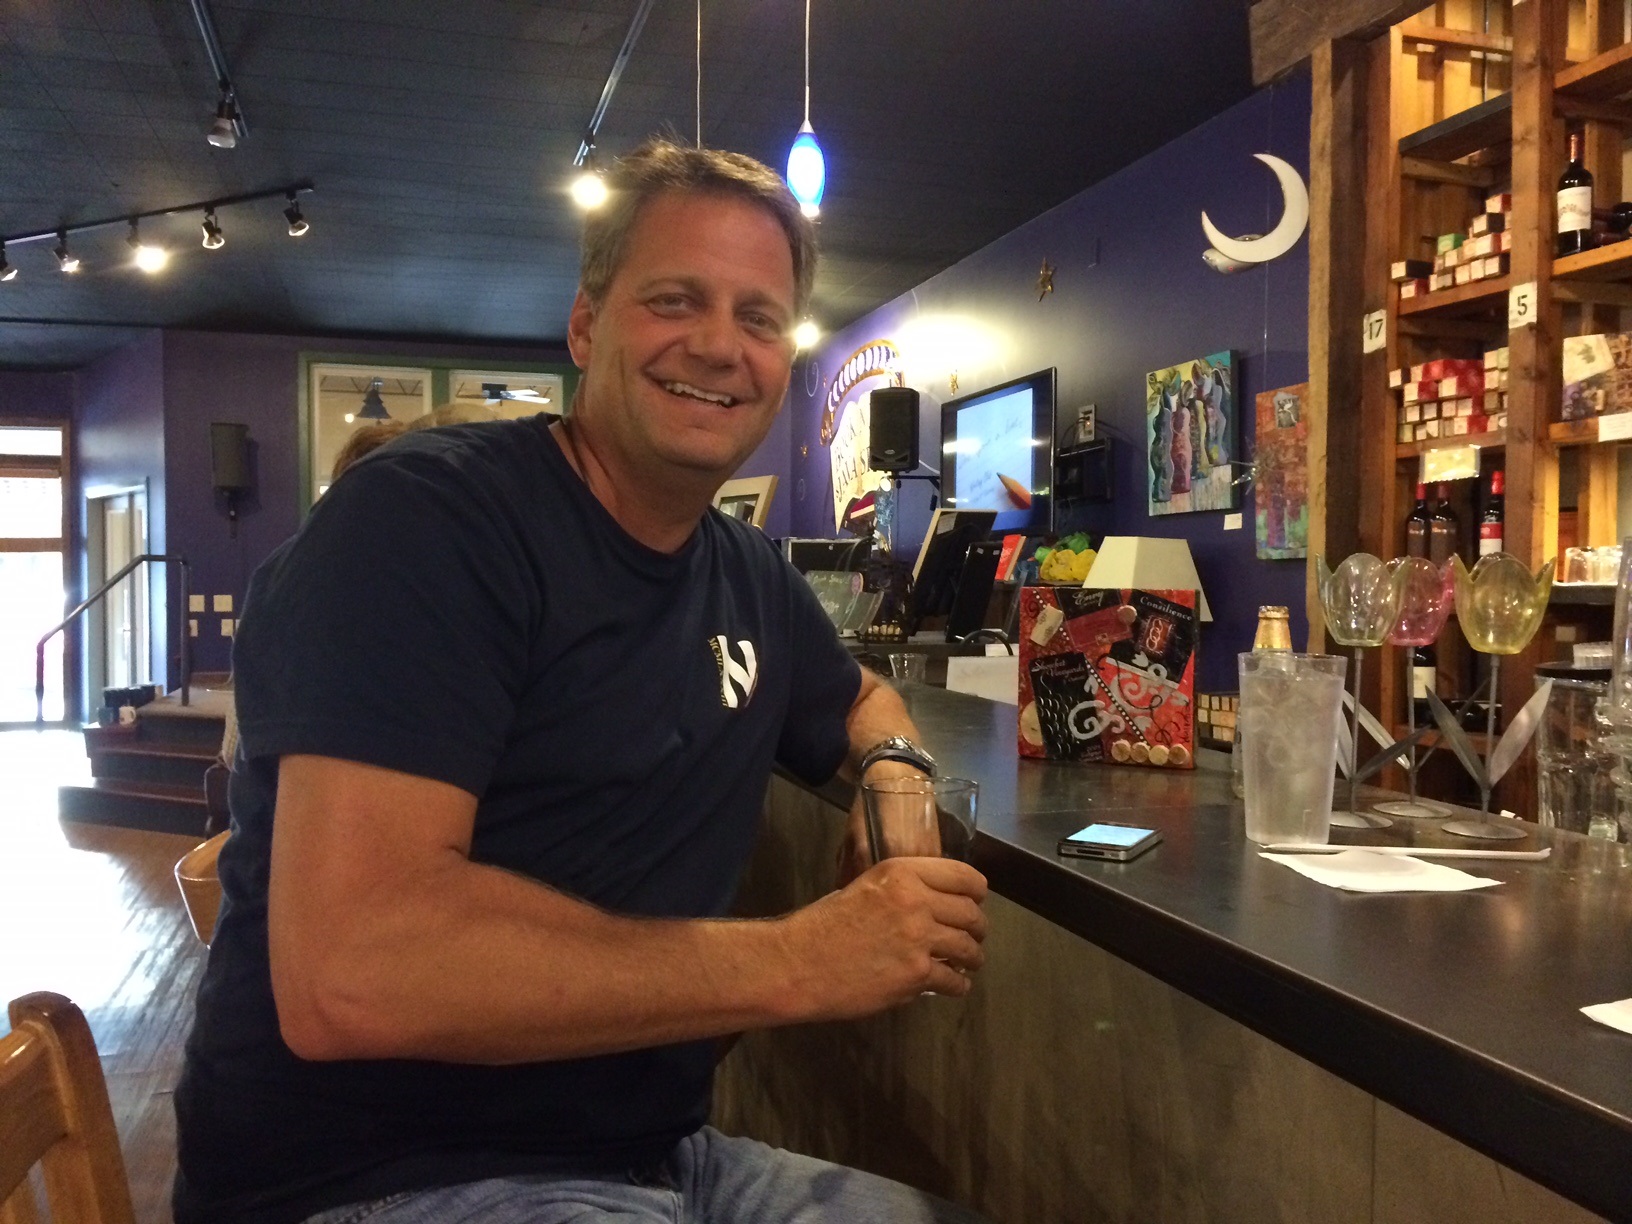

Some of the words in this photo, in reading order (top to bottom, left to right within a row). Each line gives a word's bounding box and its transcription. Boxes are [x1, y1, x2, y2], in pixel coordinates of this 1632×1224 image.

[1517, 294, 1528, 316] 5
[1369, 318, 1384, 340] 17
[1140, 596, 1193, 621] Consilience
